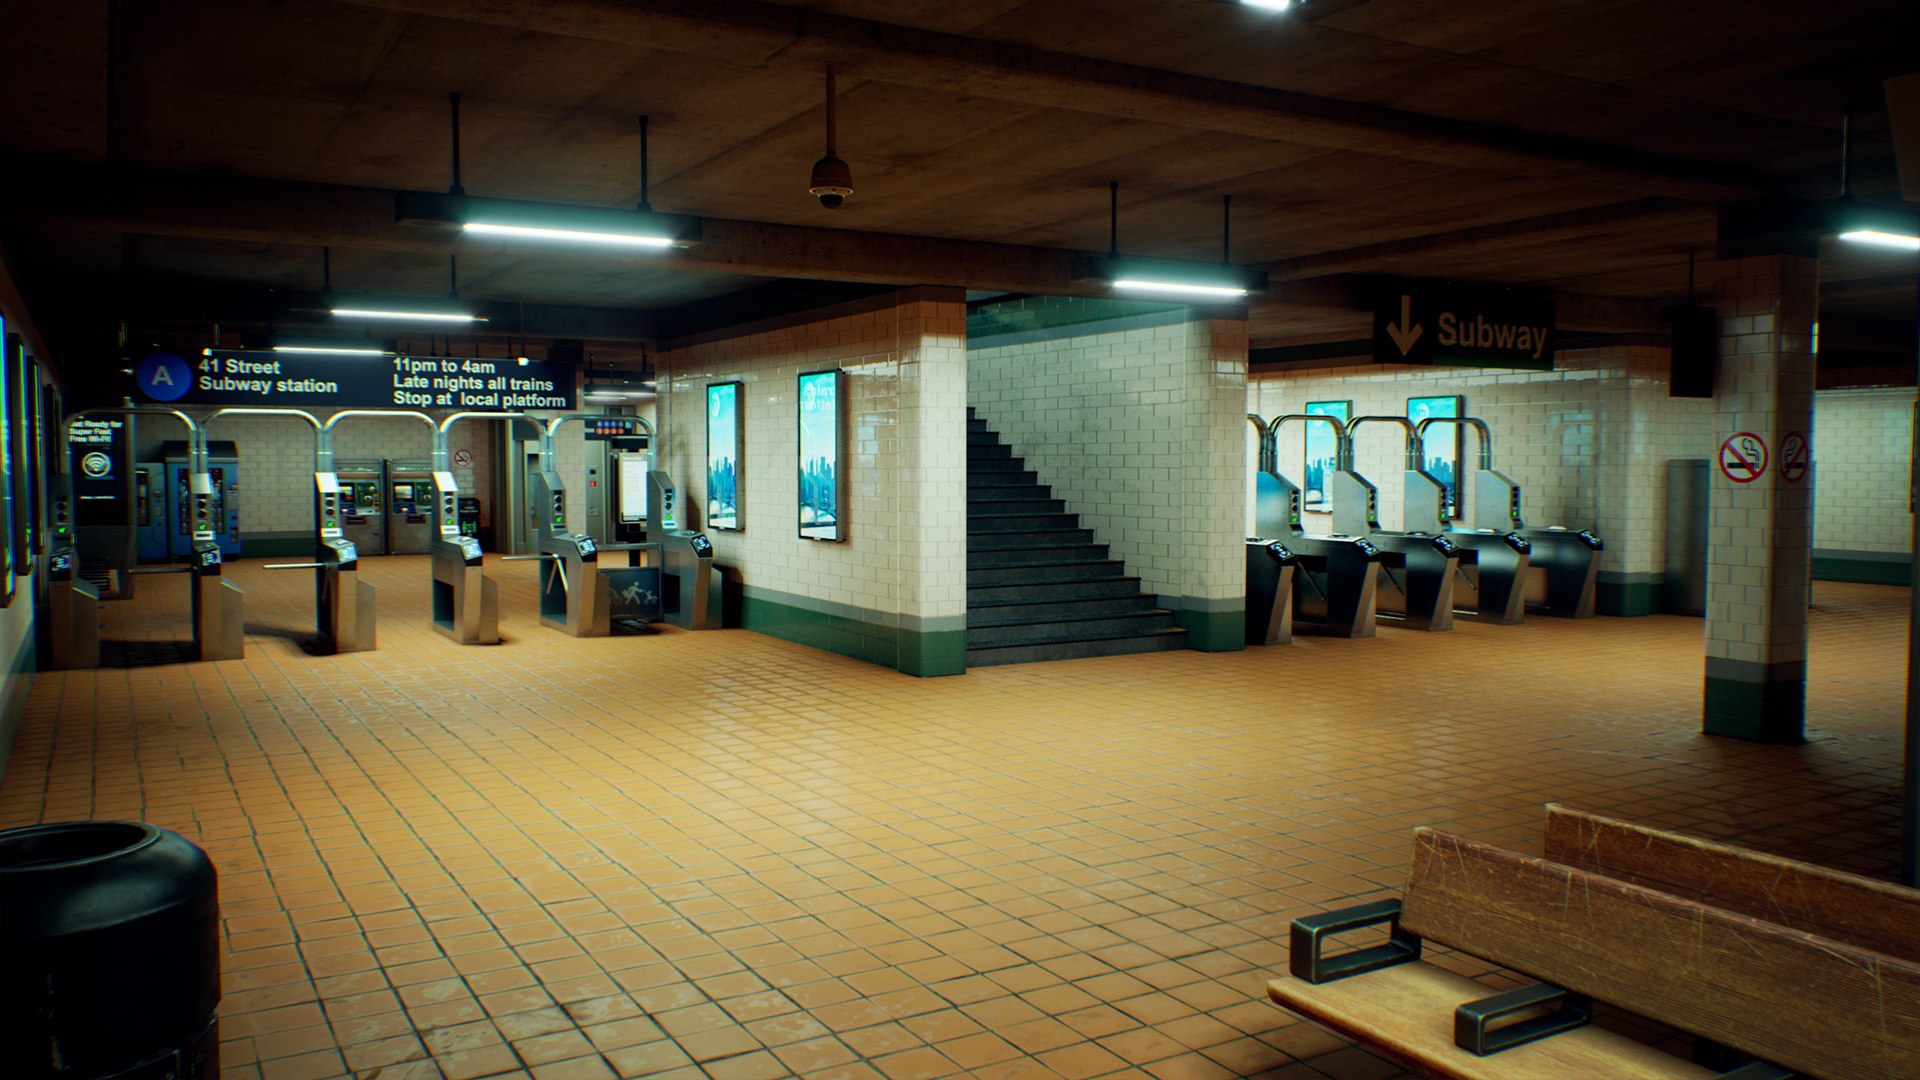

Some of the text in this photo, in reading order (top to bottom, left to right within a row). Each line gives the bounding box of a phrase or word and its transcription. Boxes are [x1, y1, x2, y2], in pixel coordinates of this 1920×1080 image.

[1438, 312, 1547, 359] Subway
[199, 358, 281, 375] 41 Street
[393, 357, 496, 374] 11pm to 4am
[152, 365, 174, 386] A
[393, 374, 554, 392] Late nights all trains
[199, 376, 339, 395] Subway station
[393, 390, 567, 409] Stop at local platform
